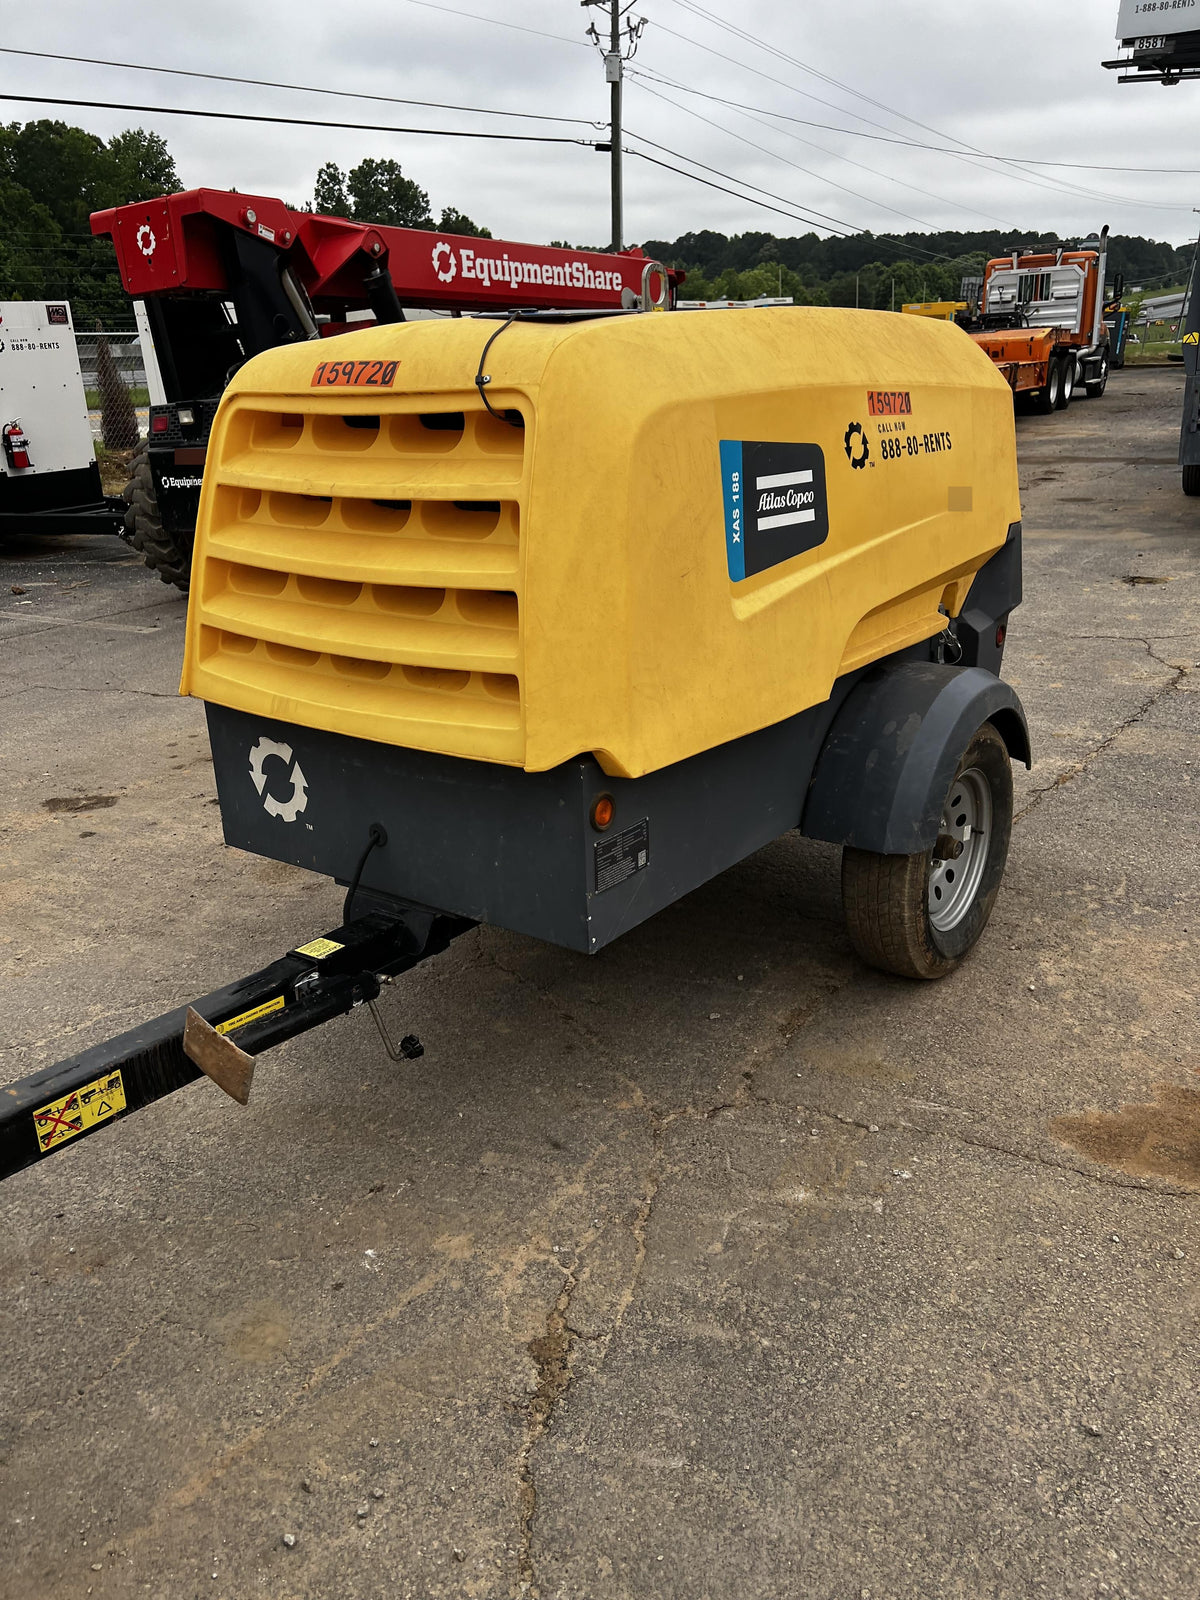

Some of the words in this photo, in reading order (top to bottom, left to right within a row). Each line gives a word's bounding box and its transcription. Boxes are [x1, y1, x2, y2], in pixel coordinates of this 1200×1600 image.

[1135, 0, 1195, 13] 1-888-80-RENTS
[1138, 37, 1166, 48] 8581
[460, 249, 622, 291] EquipmentShare
[317, 360, 400, 385] 159720
[869, 391, 911, 413] 159720
[878, 423, 892, 433] CALL
[894, 421, 906, 431] NOW
[881, 432, 952, 460] 888-80-RENTS
[169, 477, 203, 488] Equipme
